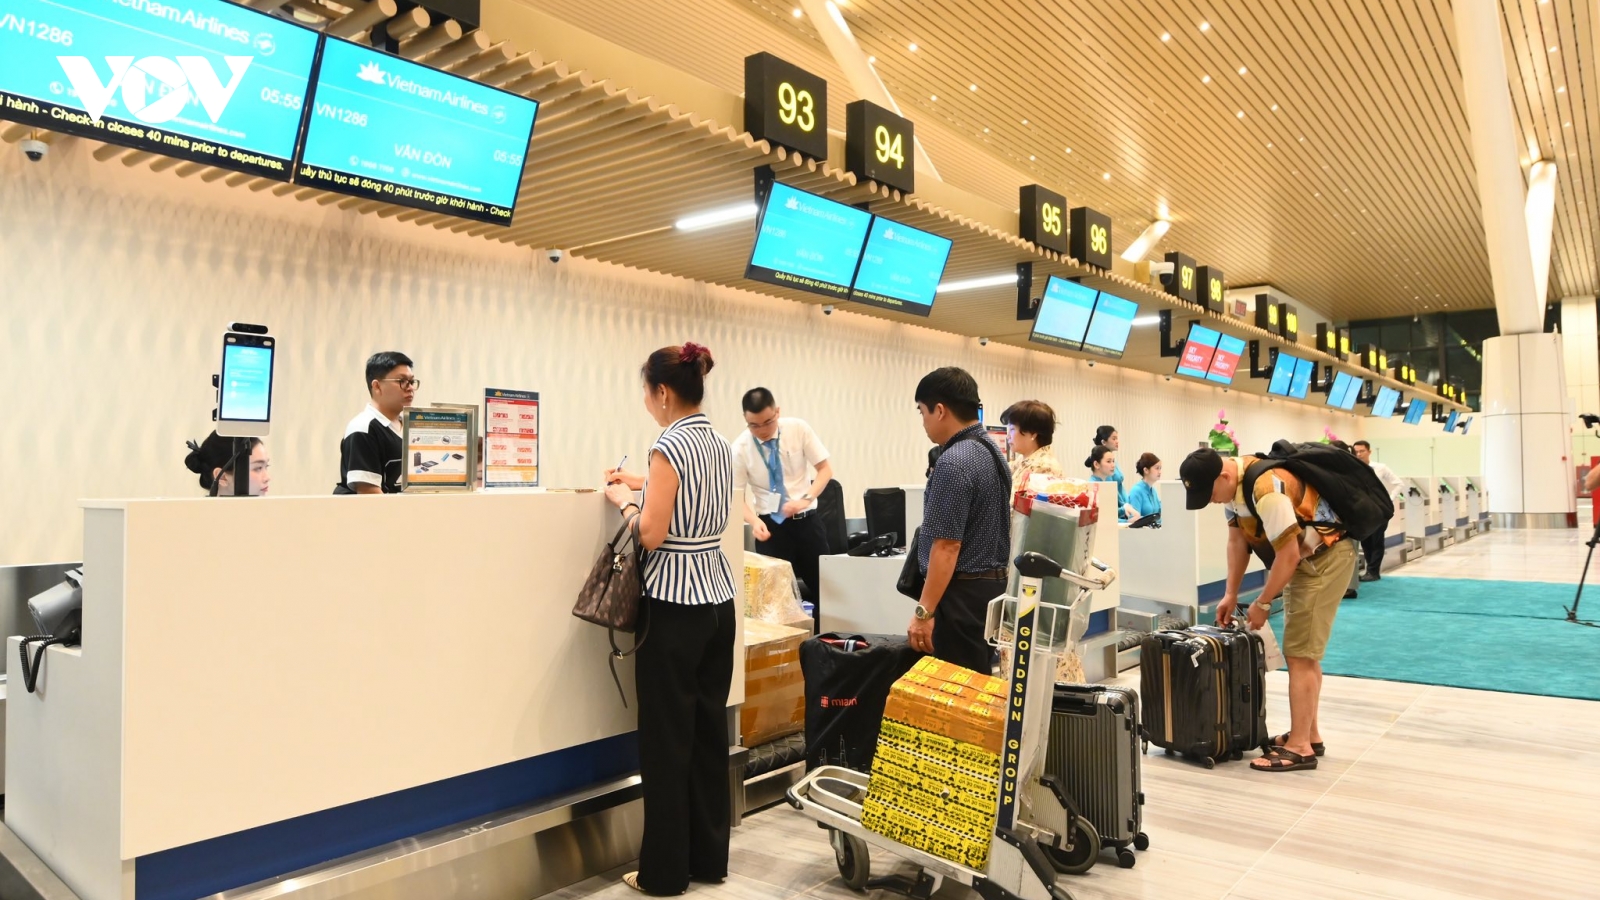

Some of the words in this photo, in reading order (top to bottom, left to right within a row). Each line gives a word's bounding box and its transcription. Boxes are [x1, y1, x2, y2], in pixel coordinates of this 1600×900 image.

[260, 87, 302, 110] 05:55
[778, 82, 815, 132] 93
[315, 102, 369, 127] VN1286
[6, 98, 39, 113] hành
[107, 122, 144, 138] closes
[146, 130, 162, 142] 40
[163, 135, 190, 149] mins
[191, 142, 217, 154] prior
[217, 147, 228, 157] to
[229, 150, 284, 170] departures.
[875, 126, 905, 169] 94
[382, 184, 394, 194] 40
[490, 206, 511, 217] Check
[1042, 203, 1061, 236] 95
[1091, 224, 1107, 254] 96
[1181, 265, 1193, 290] 97
[1011, 626, 1031, 722] GOLDSUN
[922, 766, 945, 777] FRAGILE
[1004, 739, 1019, 805] GROUP
[927, 784, 943, 792] AGILE
[941, 816, 965, 828] FRAGILE
